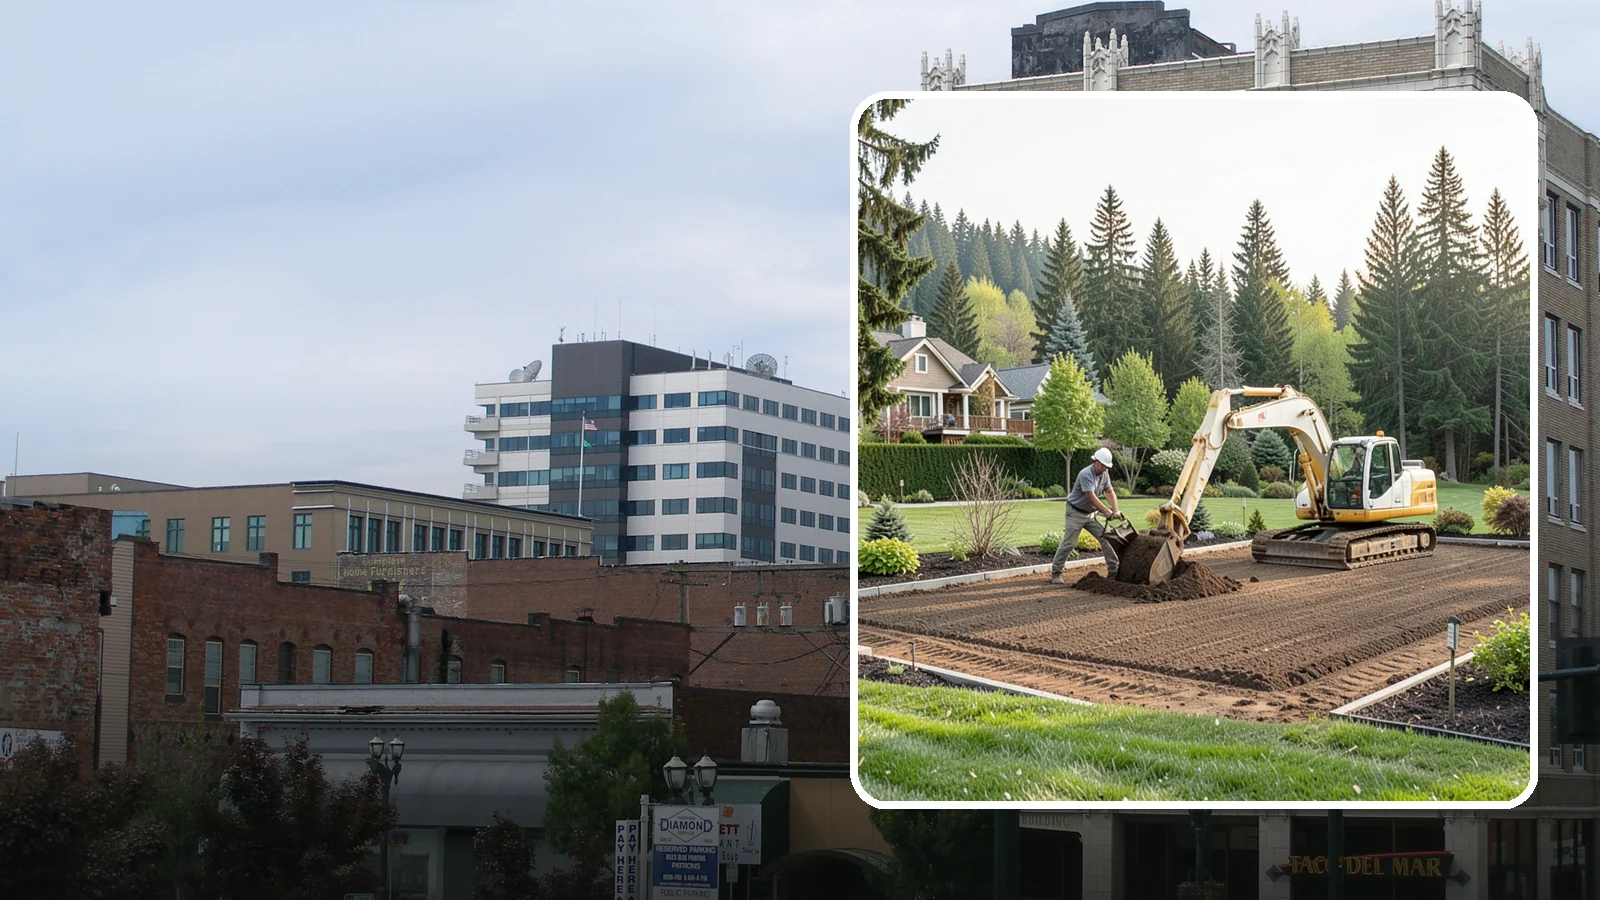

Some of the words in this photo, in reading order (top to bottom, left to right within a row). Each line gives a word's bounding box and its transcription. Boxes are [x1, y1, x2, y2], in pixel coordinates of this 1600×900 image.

[370, 566, 427, 576] Furnishers
[660, 818, 713, 832] DIAMOND
[1022, 815, 1070, 828] BUILDING
[719, 824, 740, 835] ETT
[617, 825, 625, 852] PAY
[629, 825, 637, 852] PAY
[689, 846, 716, 854] PARKING
[721, 851, 739, 862] Soup
[1346, 856, 1384, 875] DEL
[1392, 857, 1443, 877] MAR
[617, 856, 625, 894] HERE
[628, 856, 636, 894] HERE
[660, 889, 682, 897] PUBLIC
[684, 889, 710, 898] PARKING
